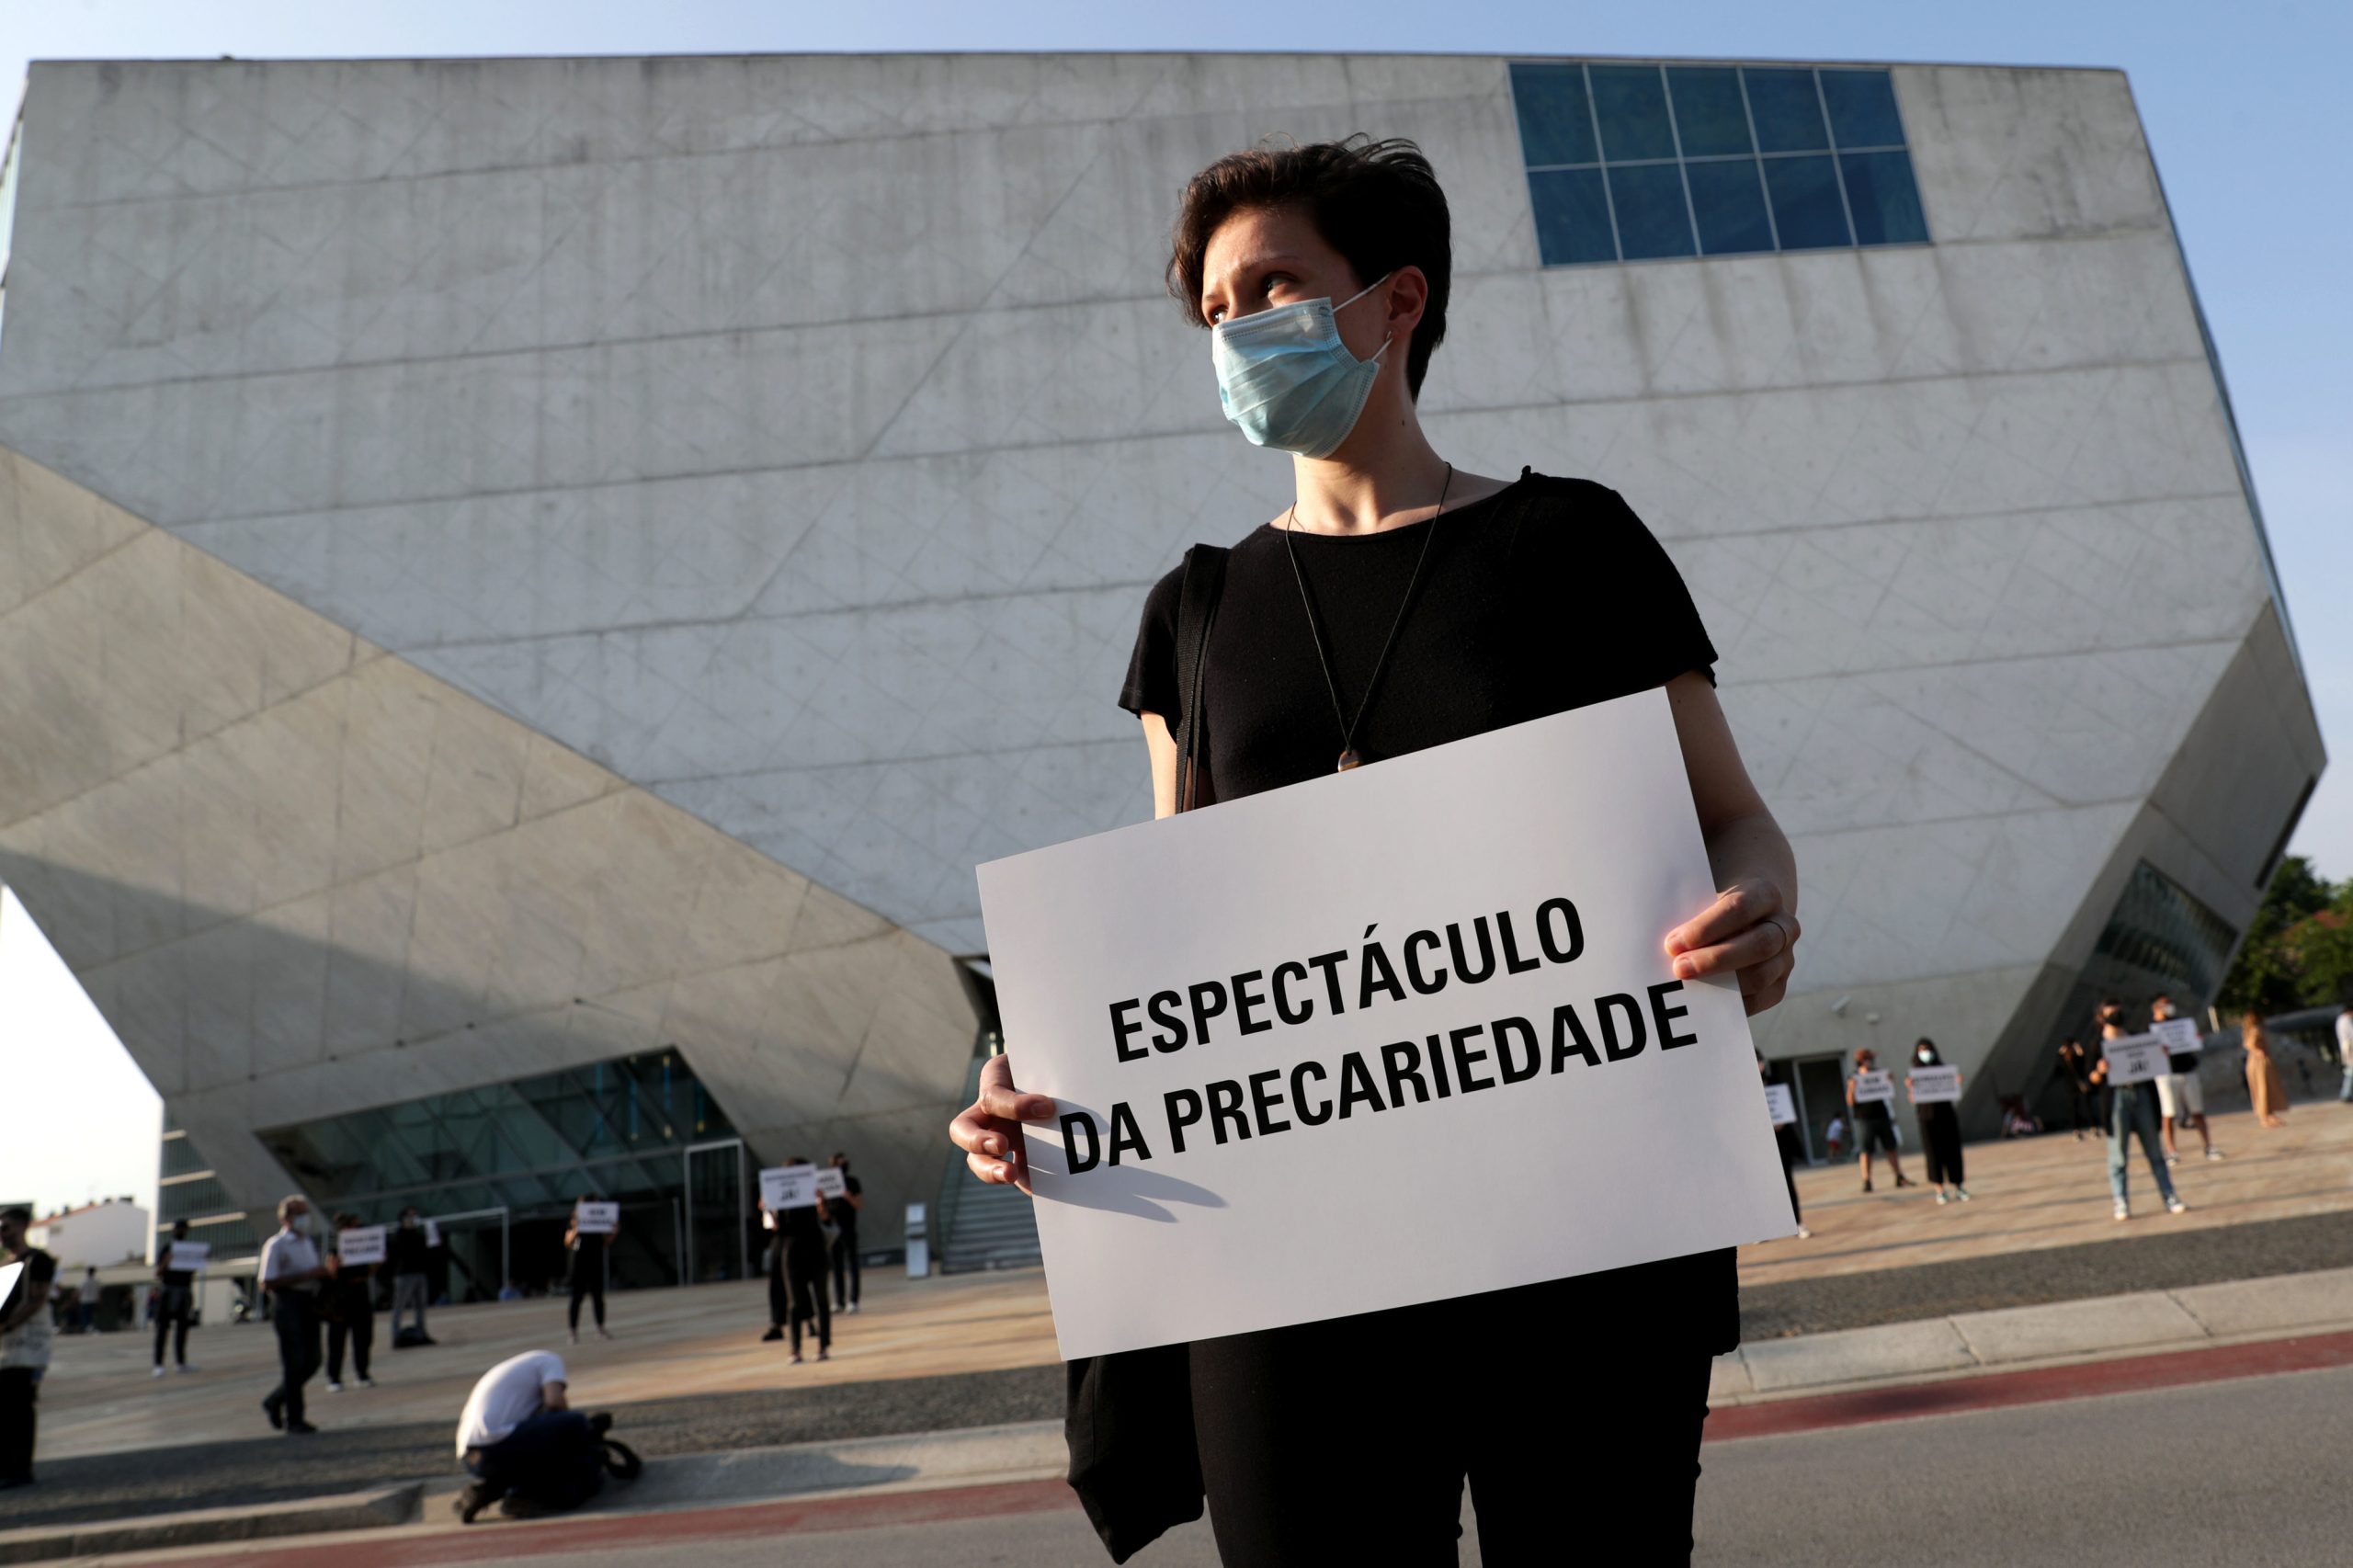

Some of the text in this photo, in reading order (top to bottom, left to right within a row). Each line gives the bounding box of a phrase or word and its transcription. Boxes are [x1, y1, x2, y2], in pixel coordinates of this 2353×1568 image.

[1108, 897, 1585, 1063] ESPECTÁCULO
[1059, 979, 1699, 1175] DA PRECARIEDADE
